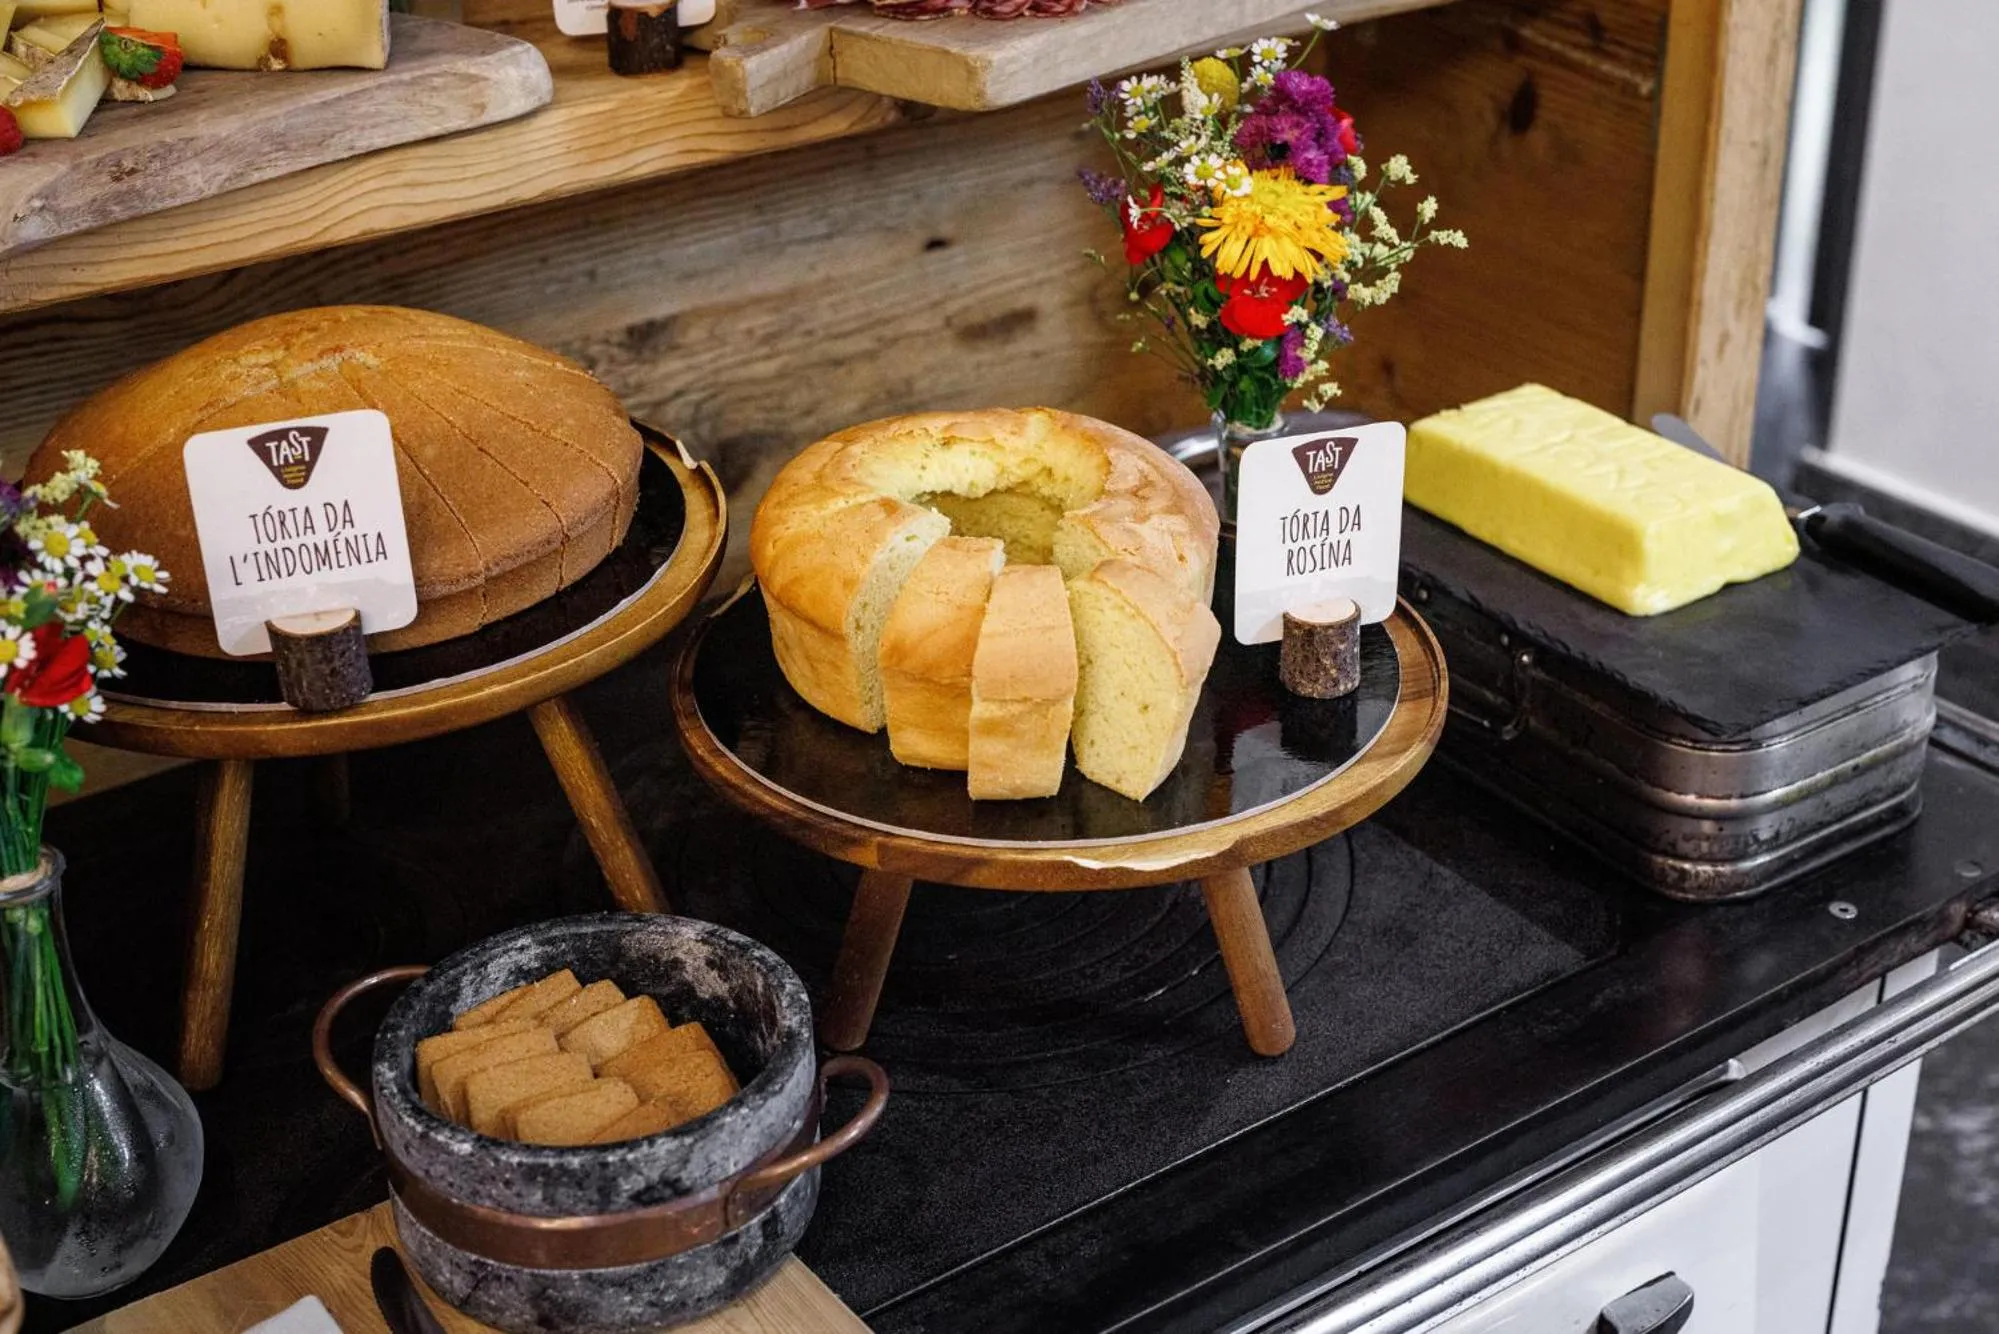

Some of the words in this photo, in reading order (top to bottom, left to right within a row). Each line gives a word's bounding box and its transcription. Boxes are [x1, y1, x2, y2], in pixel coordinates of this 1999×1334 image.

[265, 430, 312, 467] TAST
[1306, 440, 1343, 473] TAST
[249, 505, 316, 545] TÓRTA
[323, 499, 355, 533] DA
[1279, 508, 1330, 545] TÓRTA
[1338, 504, 1362, 535] DA
[1286, 537, 1353, 577] ROSÍNA
